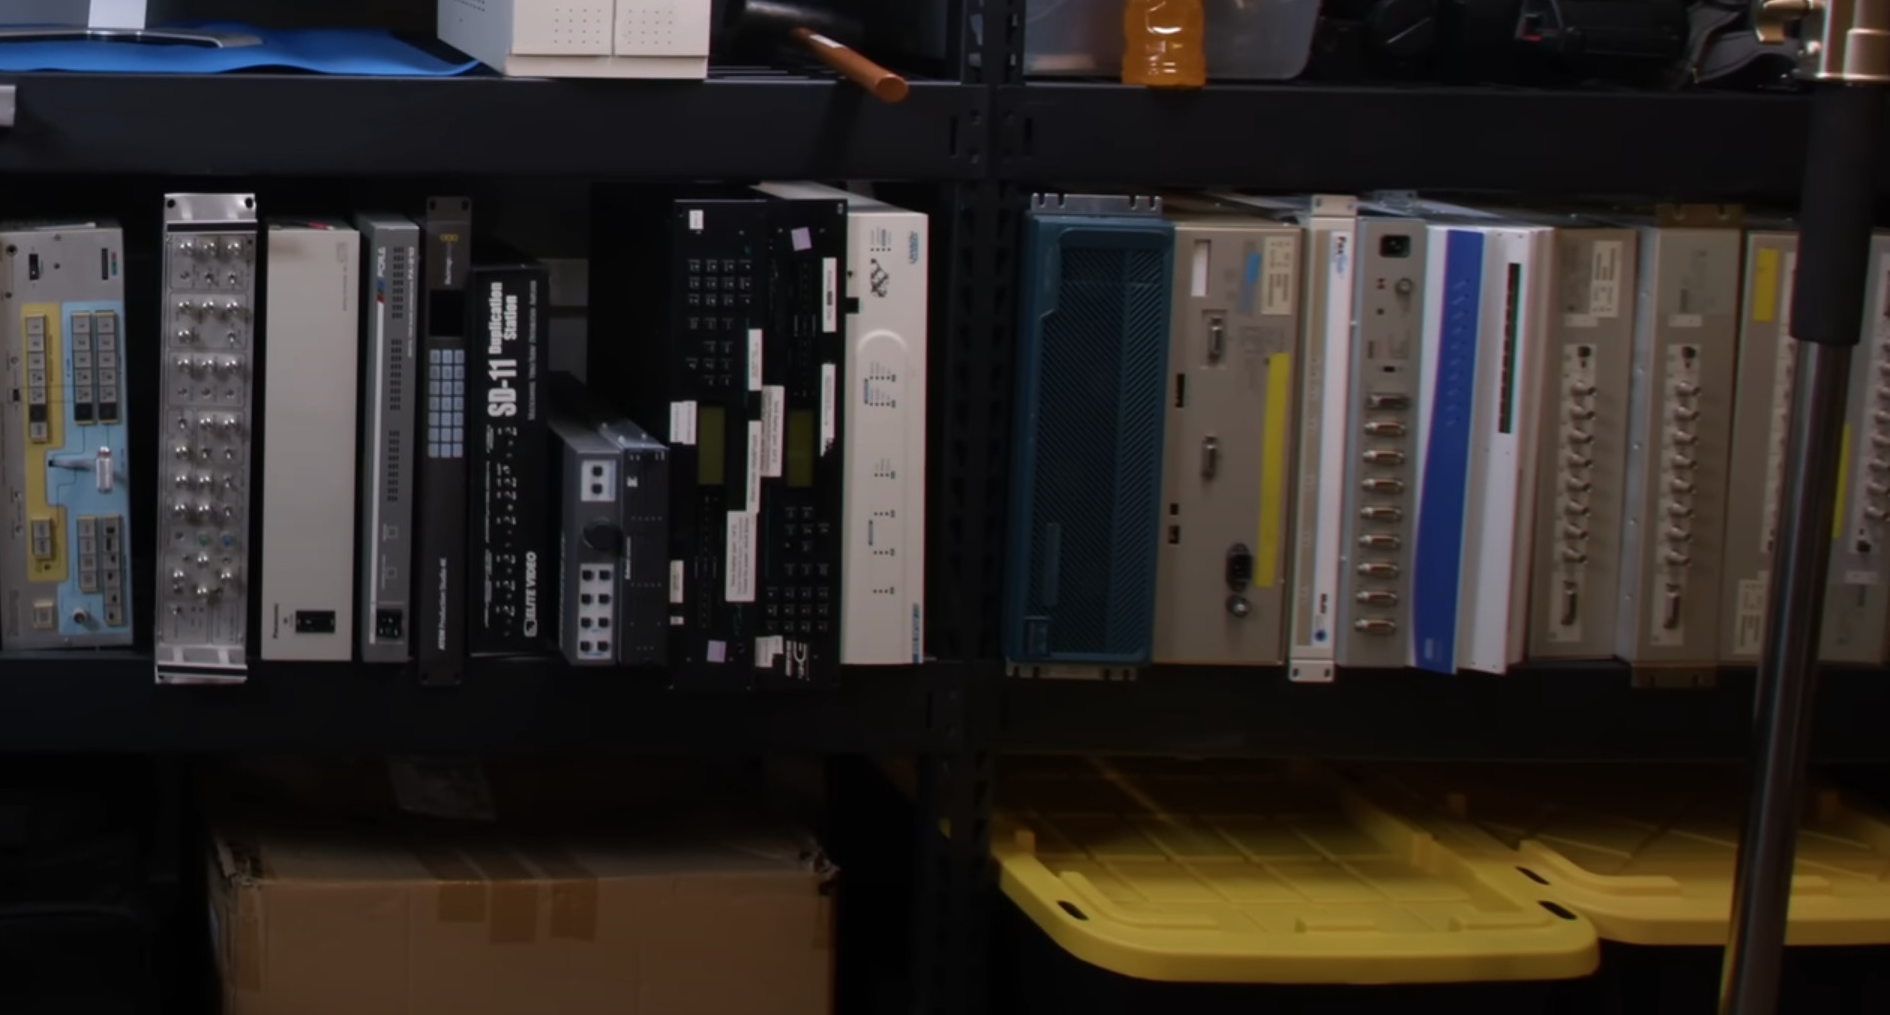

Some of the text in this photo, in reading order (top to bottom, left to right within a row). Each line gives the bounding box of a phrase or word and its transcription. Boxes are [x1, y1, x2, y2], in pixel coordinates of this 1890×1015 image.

[489, 281, 503, 354] Duplication
[503, 295, 518, 341] Station
[487, 358, 517, 418] SD-11
[526, 551, 538, 622] ELITE VIDEO
